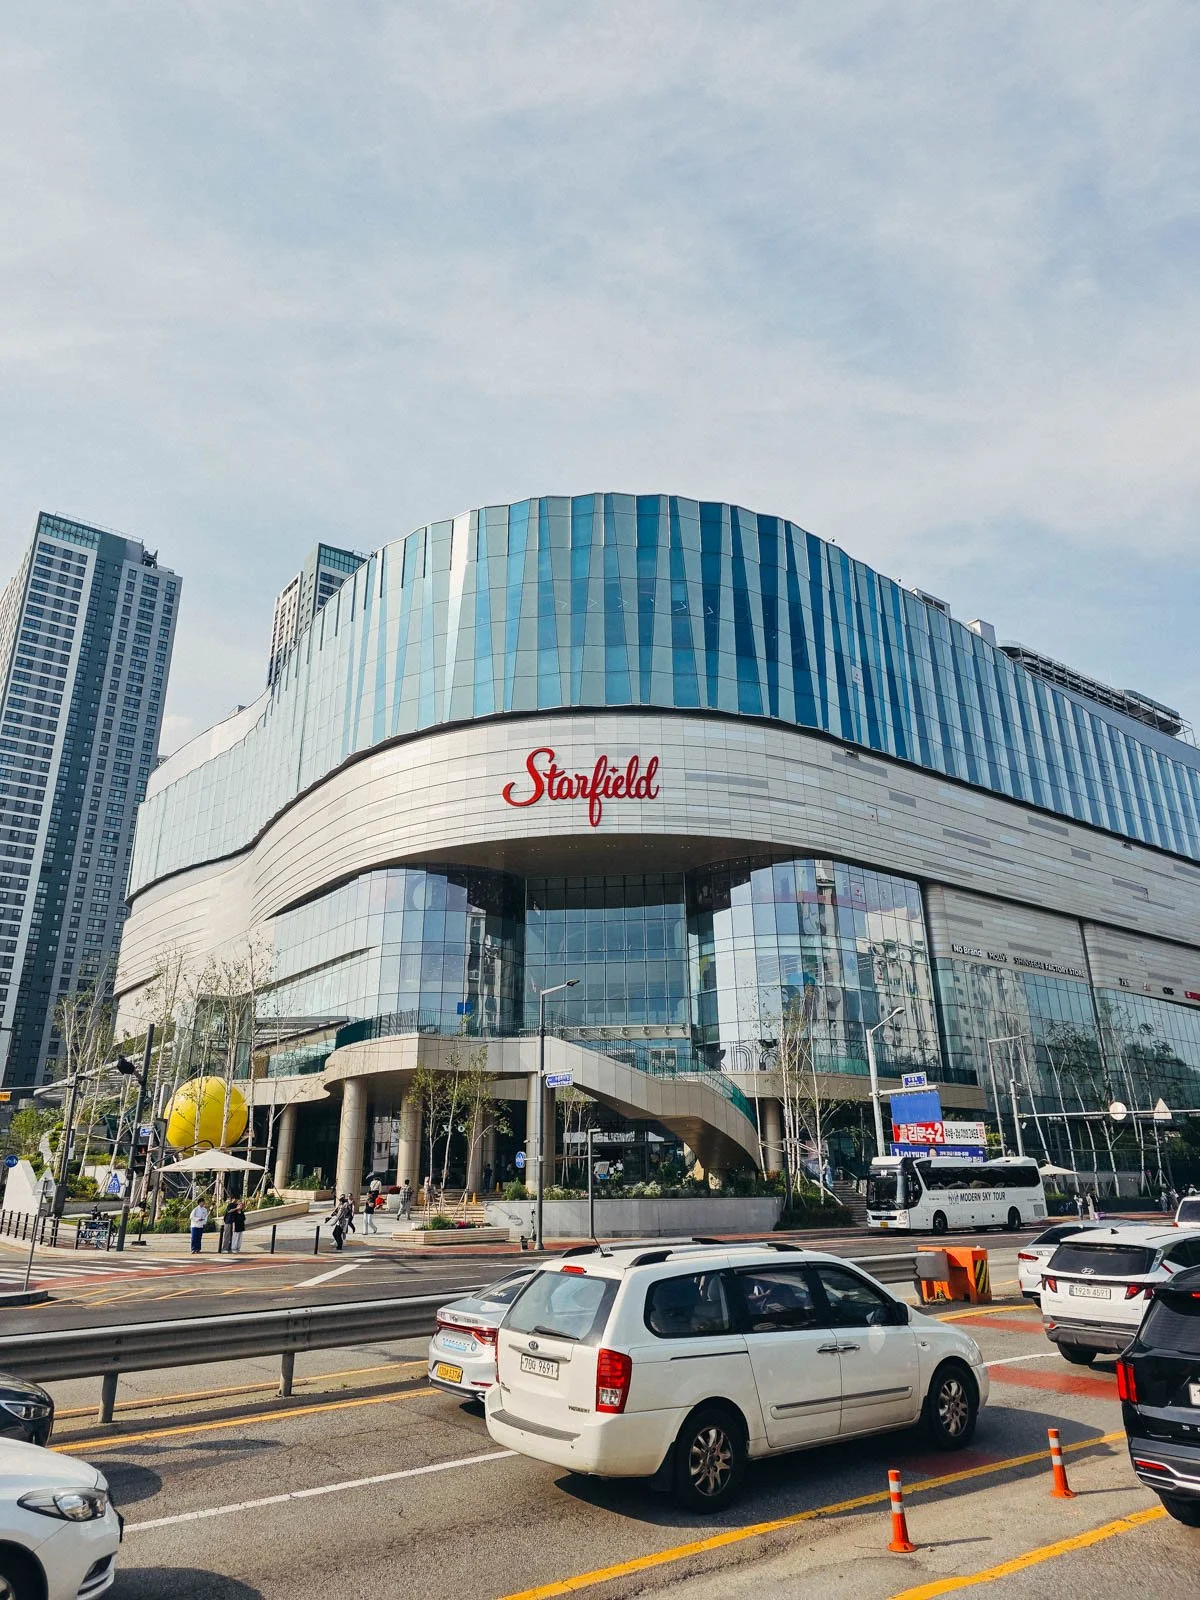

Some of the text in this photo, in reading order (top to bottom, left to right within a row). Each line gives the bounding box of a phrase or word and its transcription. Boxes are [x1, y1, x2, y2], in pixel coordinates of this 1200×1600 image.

[502, 748, 659, 827] Starfield
[952, 944, 982, 957] No Brand
[1044, 962, 1069, 975] FACTORY
[1069, 967, 1086, 978] STORE
[960, 1192, 981, 1202] MODERN
[982, 1192, 991, 1201] SKY
[993, 1191, 1006, 1201] TOUR
[1092, 1289, 1108, 1297] 4591
[538, 1360, 554, 1375] 9691
